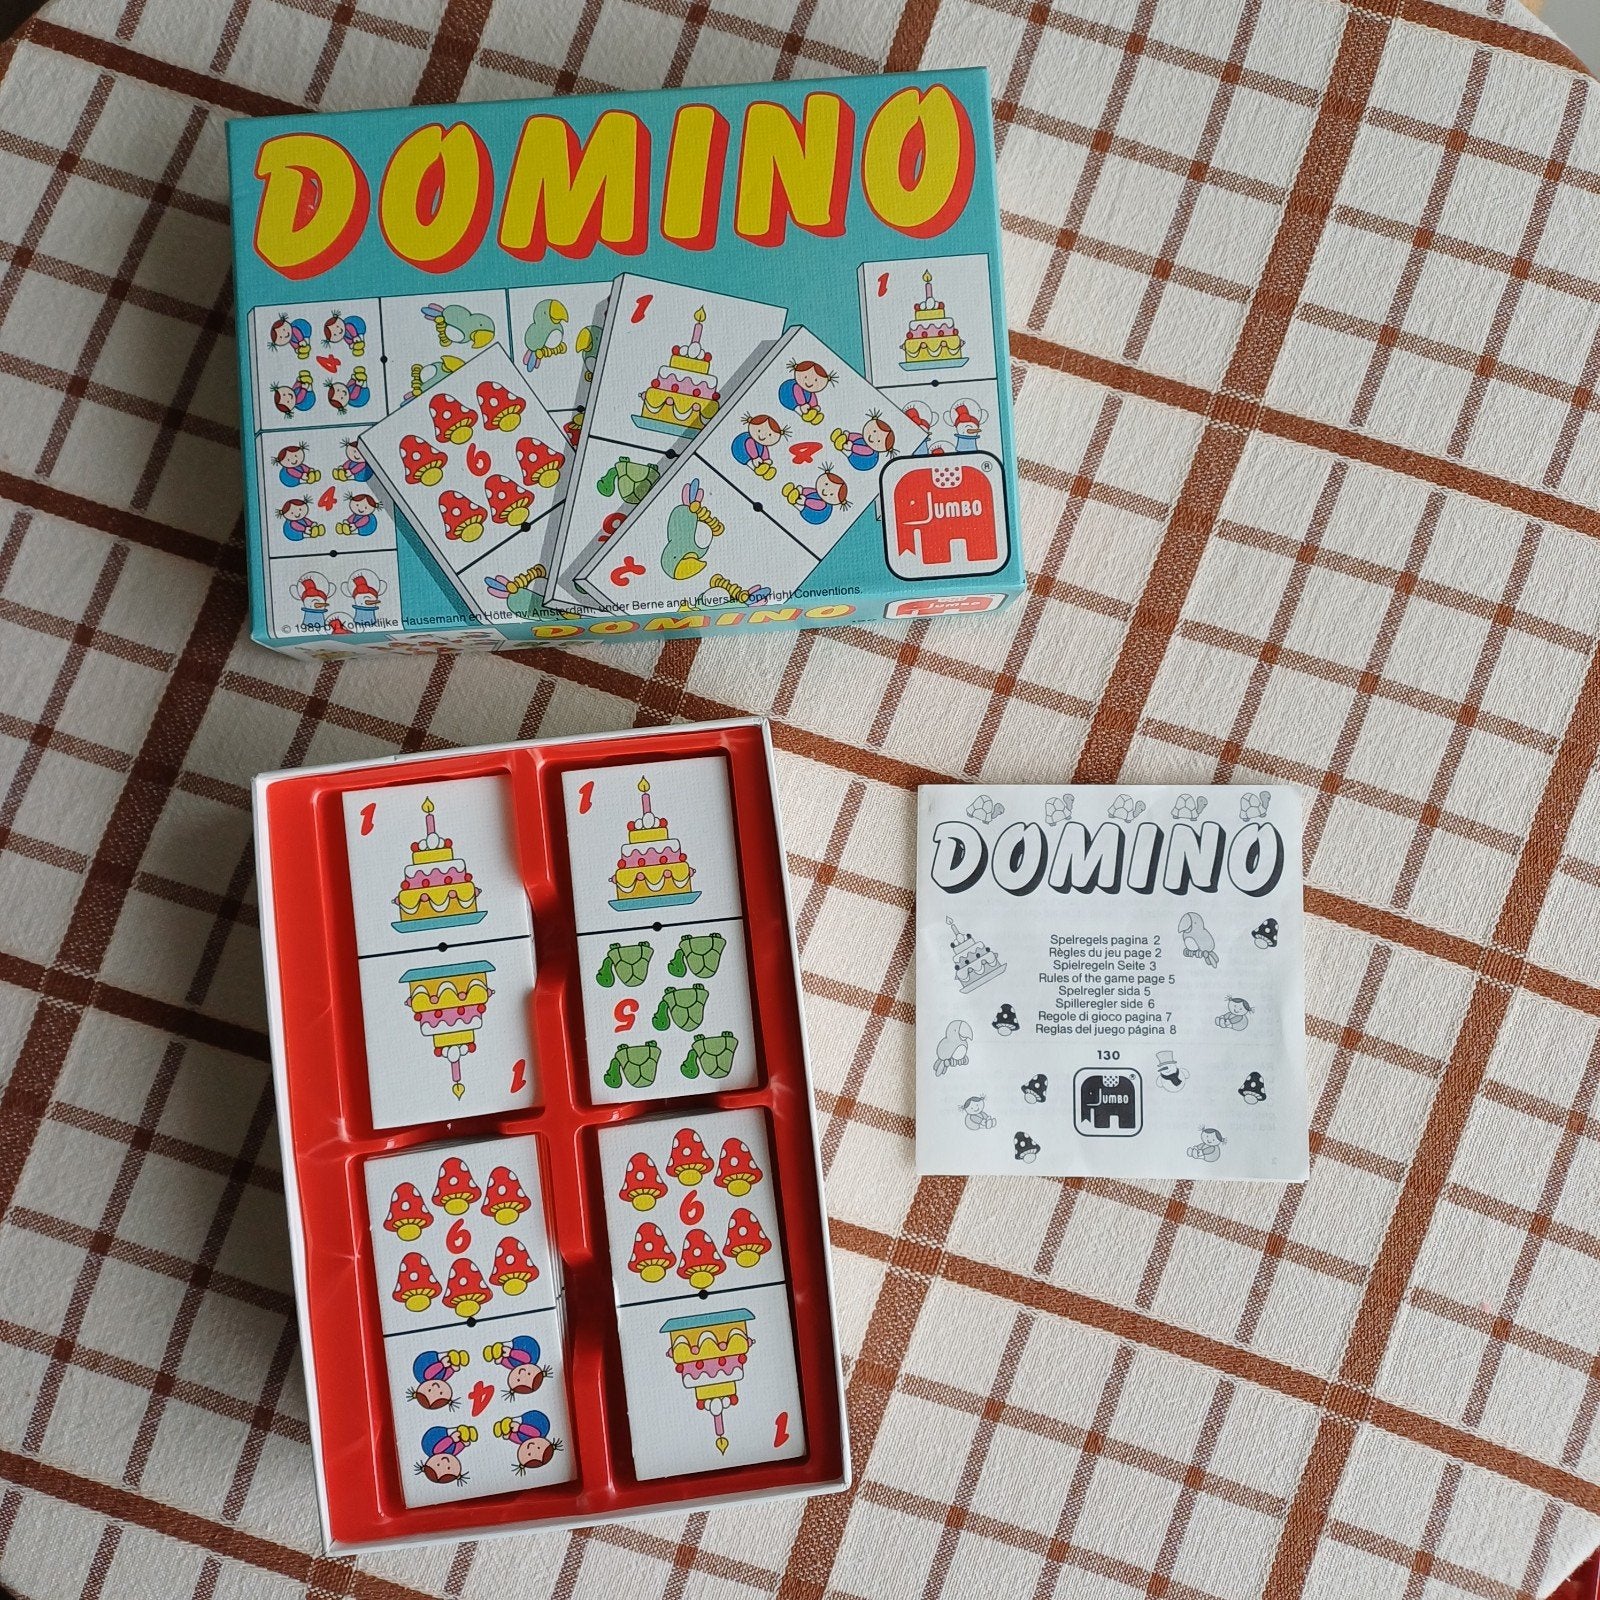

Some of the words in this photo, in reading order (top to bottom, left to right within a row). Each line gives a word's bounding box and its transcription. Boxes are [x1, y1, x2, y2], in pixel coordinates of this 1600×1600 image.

[252, 82, 977, 280] DOMINO
[877, 272, 890, 297] 1
[630, 294, 654, 324] 1
[466, 443, 492, 477] 6
[788, 441, 824, 465] 4
[317, 486, 338, 512] 4
[295, 621, 321, 633] 1989
[402, 612, 466, 626] Hausemann
[468, 611, 483, 621] en
[484, 608, 513, 621] Hötte
[532, 602, 597, 619] Amsterdam,
[598, 600, 630, 614] under
[632, 599, 665, 611] Berne
[666, 597, 687, 608] and
[688, 592, 739, 608] Universal
[794, 584, 863, 599] Conventions.
[531, 603, 857, 639] DOMINO
[578, 781, 596, 816] 1
[360, 802, 378, 836] 1
[930, 820, 1285, 897] DOMINO
[1049, 947, 1086, 959] Règles
[1088, 947, 1101, 958] du
[1103, 947, 1121, 959] jeu
[1124, 949, 1152, 960] page
[1154, 948, 1162, 958] 2
[1050, 934, 1109, 947] Spelregels
[1110, 935, 1149, 947] pagina
[1153, 935, 1161, 946] 2
[1052, 959, 1115, 972] Spielregeln
[1117, 960, 1146, 971] Seite
[1149, 960, 1157, 971] 3
[1038, 972, 1070, 984] Rules
[1071, 972, 1083, 984] of
[1084, 972, 1102, 984] the
[1104, 974, 1135, 986] game
[1137, 975, 1166, 986] page
[1168, 974, 1176, 985] 5
[1058, 985, 1116, 998] Spelregler
[1117, 985, 1141, 997] sida
[1143, 985, 1151, 997] 5
[1038, 1010, 1077, 1023] Regole
[1078, 1010, 1089, 1022] di
[1091, 1011, 1123, 1024] gioco
[1124, 1012, 1162, 1024] pagina
[1165, 1011, 1173, 1022] 7
[1055, 997, 1118, 1011] Spilleregler
[1120, 998, 1143, 1009] side
[1147, 998, 1155, 1009] 6
[1035, 1023, 1073, 1036] Reglas
[1075, 1023, 1092, 1035] del
[1094, 1024, 1126, 1037] juego
[1127, 1024, 1165, 1037] página
[1169, 1024, 1177, 1035] 8
[1096, 1049, 1121, 1061] 130
[510, 1058, 527, 1094] 1
[1086, 1088, 1130, 1107] JUMBO
[679, 1189, 706, 1226] 6
[445, 1218, 472, 1255] 6
[773, 1411, 790, 1448] 1
